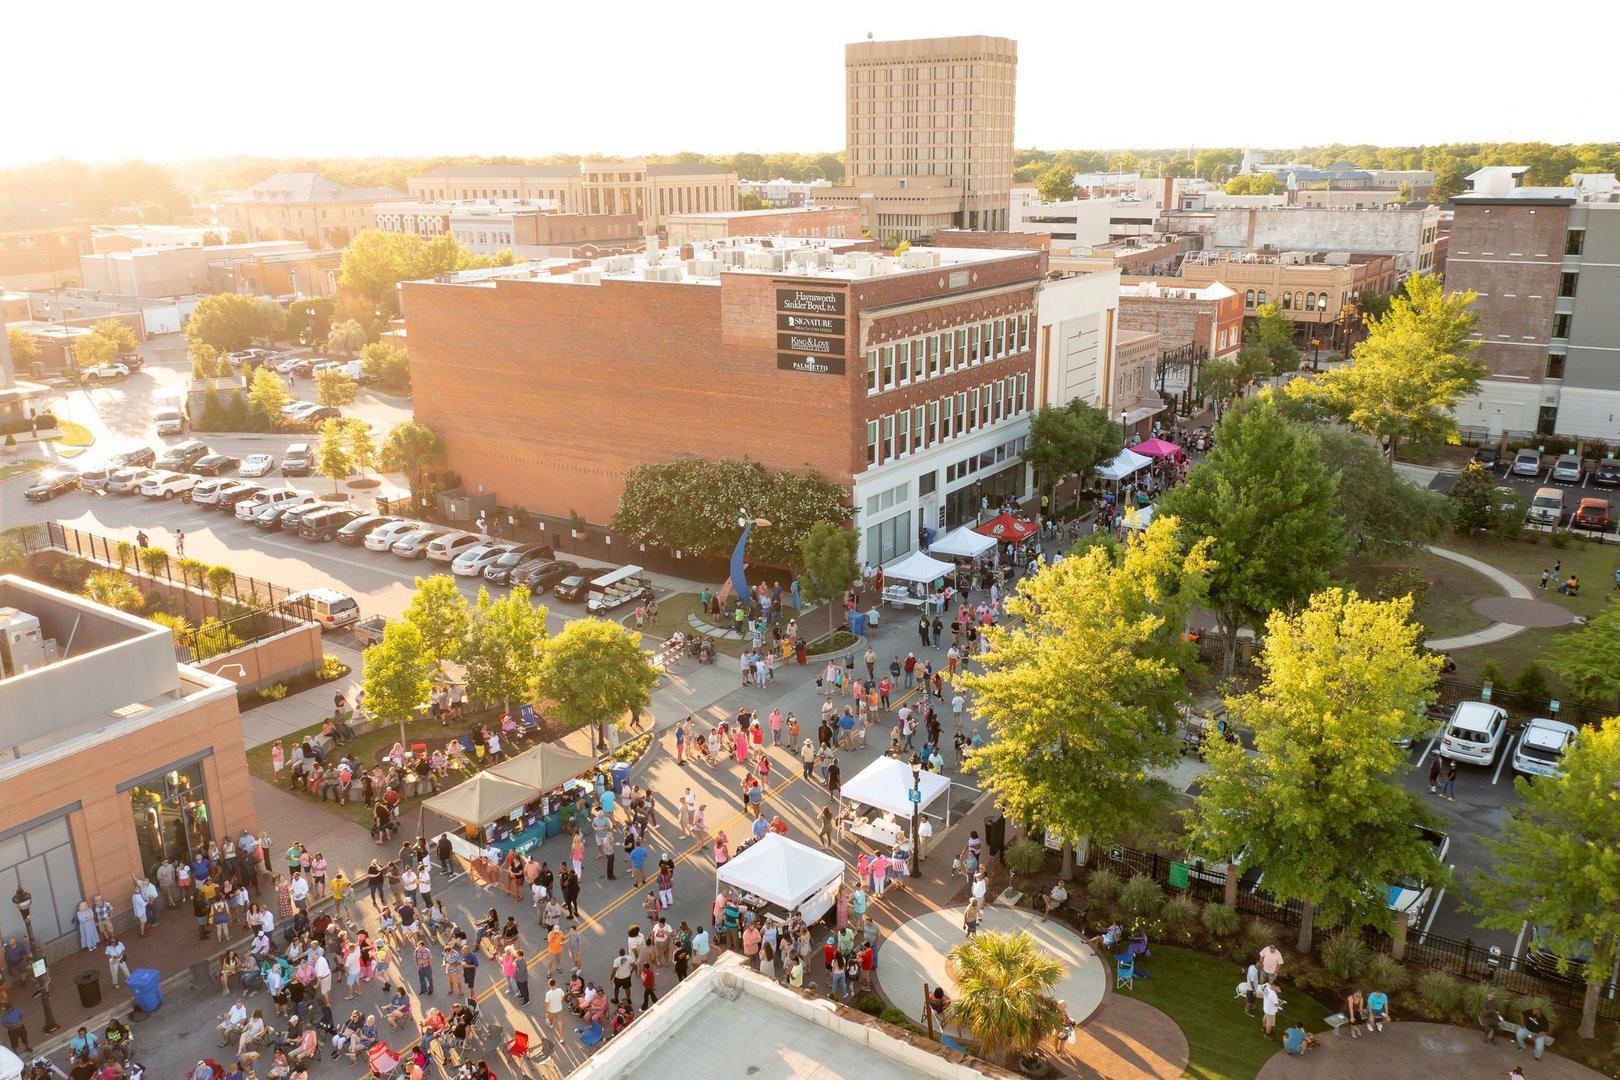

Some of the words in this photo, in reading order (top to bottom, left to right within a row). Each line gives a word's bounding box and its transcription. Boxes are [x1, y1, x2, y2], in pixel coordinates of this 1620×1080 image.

[796, 292, 836, 303] Haynsworth
[784, 300, 806, 308] Sinkler
[807, 301, 826, 312] Boyd,
[794, 318, 832, 328] SIGNATURE
